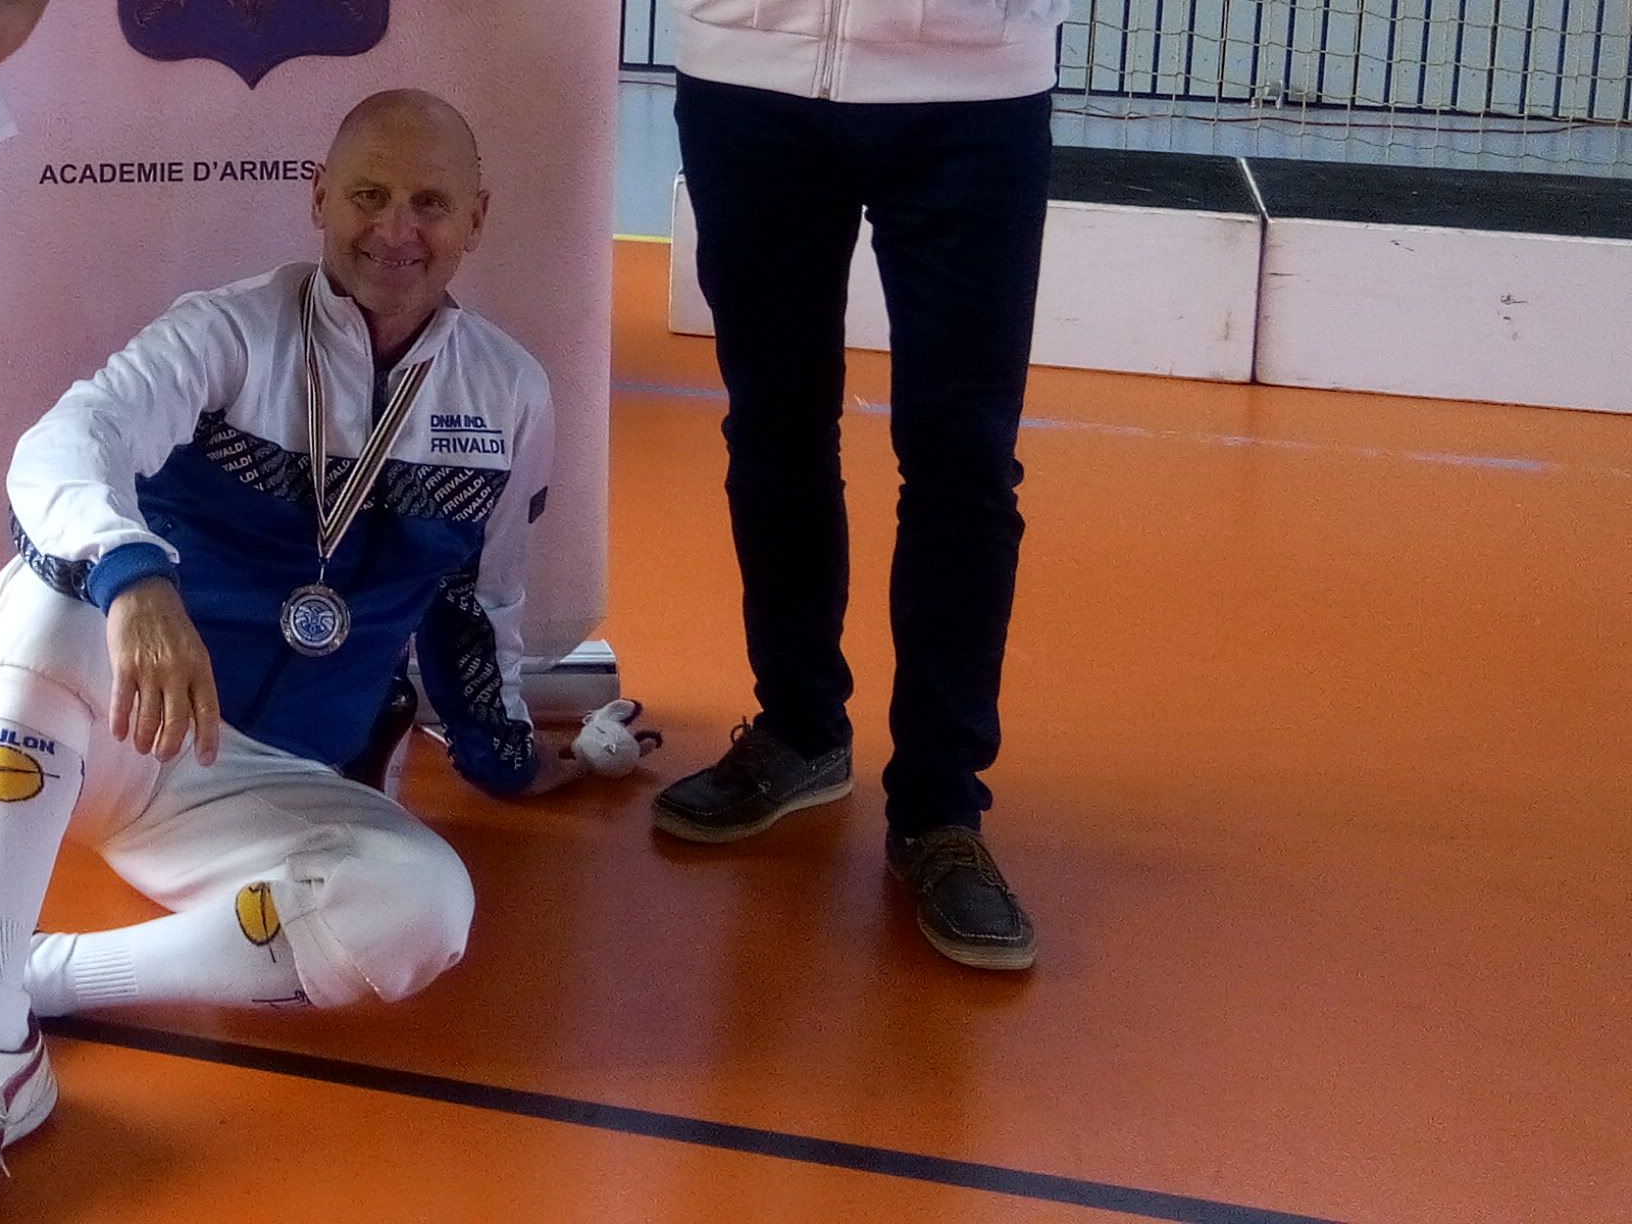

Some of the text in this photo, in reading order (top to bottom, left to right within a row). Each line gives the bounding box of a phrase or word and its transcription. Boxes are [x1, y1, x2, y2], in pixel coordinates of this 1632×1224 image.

[38, 160, 316, 185] ACADEMIE D'ARMES
[430, 437, 506, 455] FRIVALDI
